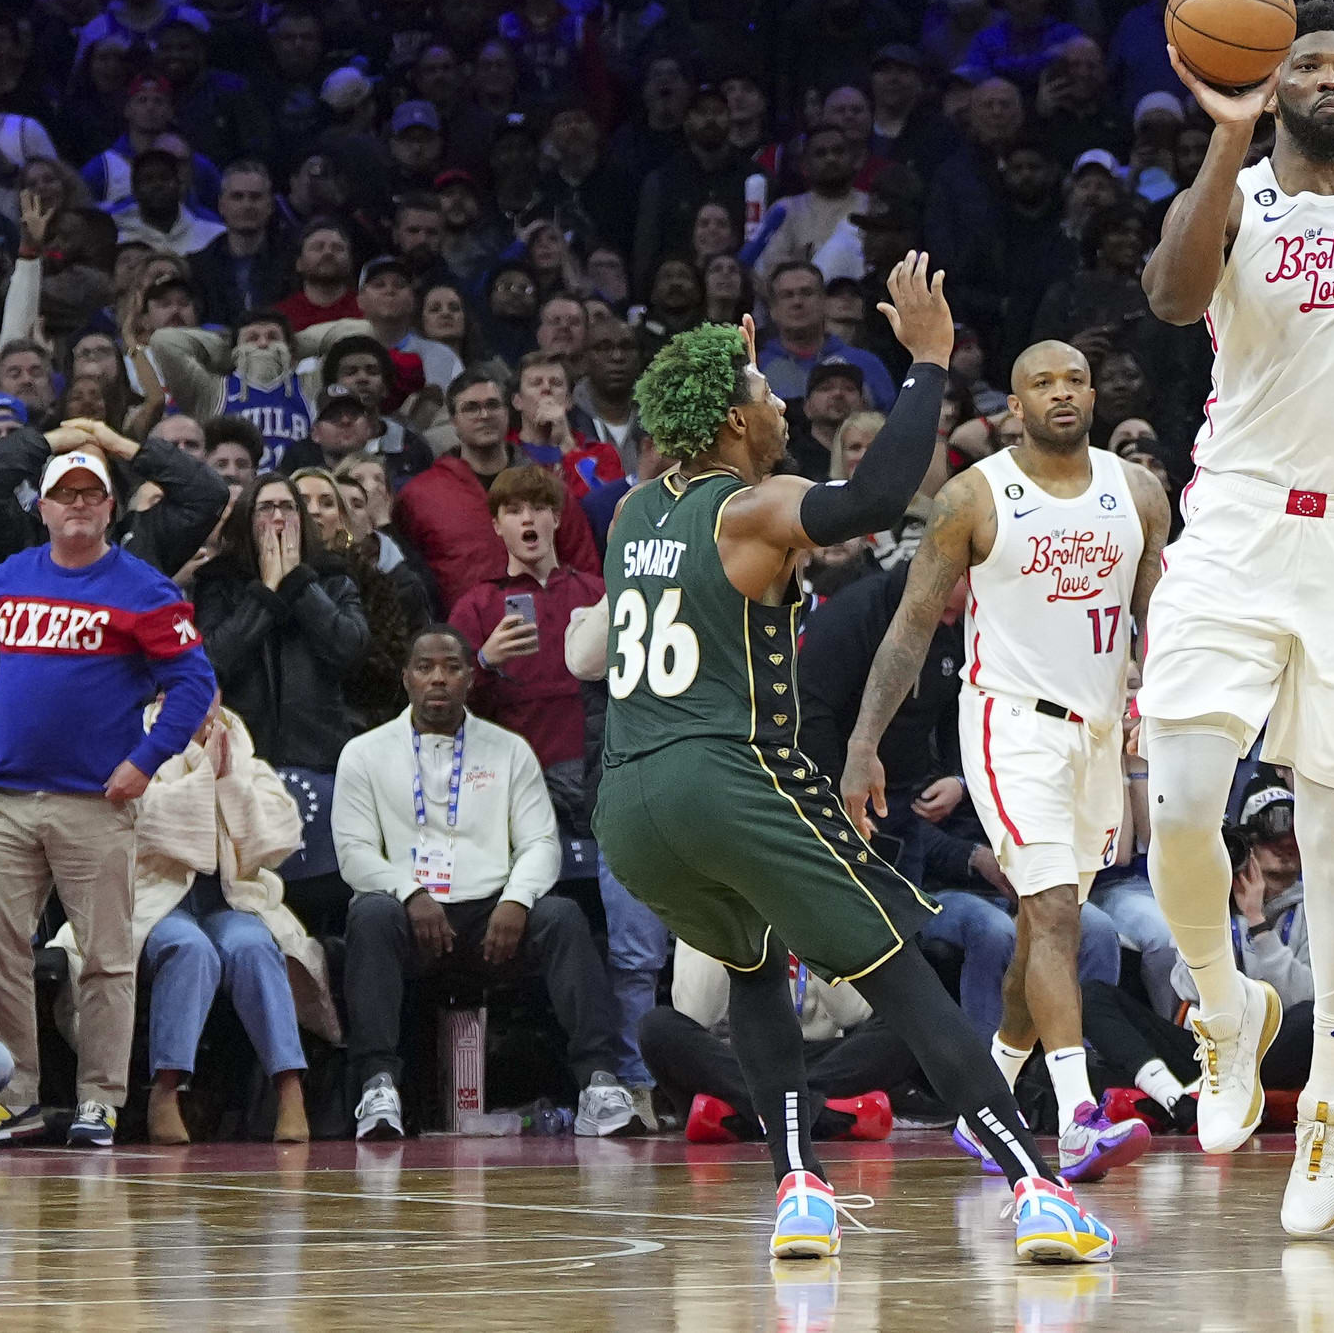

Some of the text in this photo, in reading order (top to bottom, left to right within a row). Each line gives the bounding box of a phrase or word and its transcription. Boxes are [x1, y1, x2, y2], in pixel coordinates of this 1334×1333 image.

[624, 538, 687, 579] SMART
[1021, 530, 1123, 578] Brotherly
[1047, 567, 1104, 603] Love
[609, 587, 700, 700] 36
[1087, 605, 1121, 655] 17
